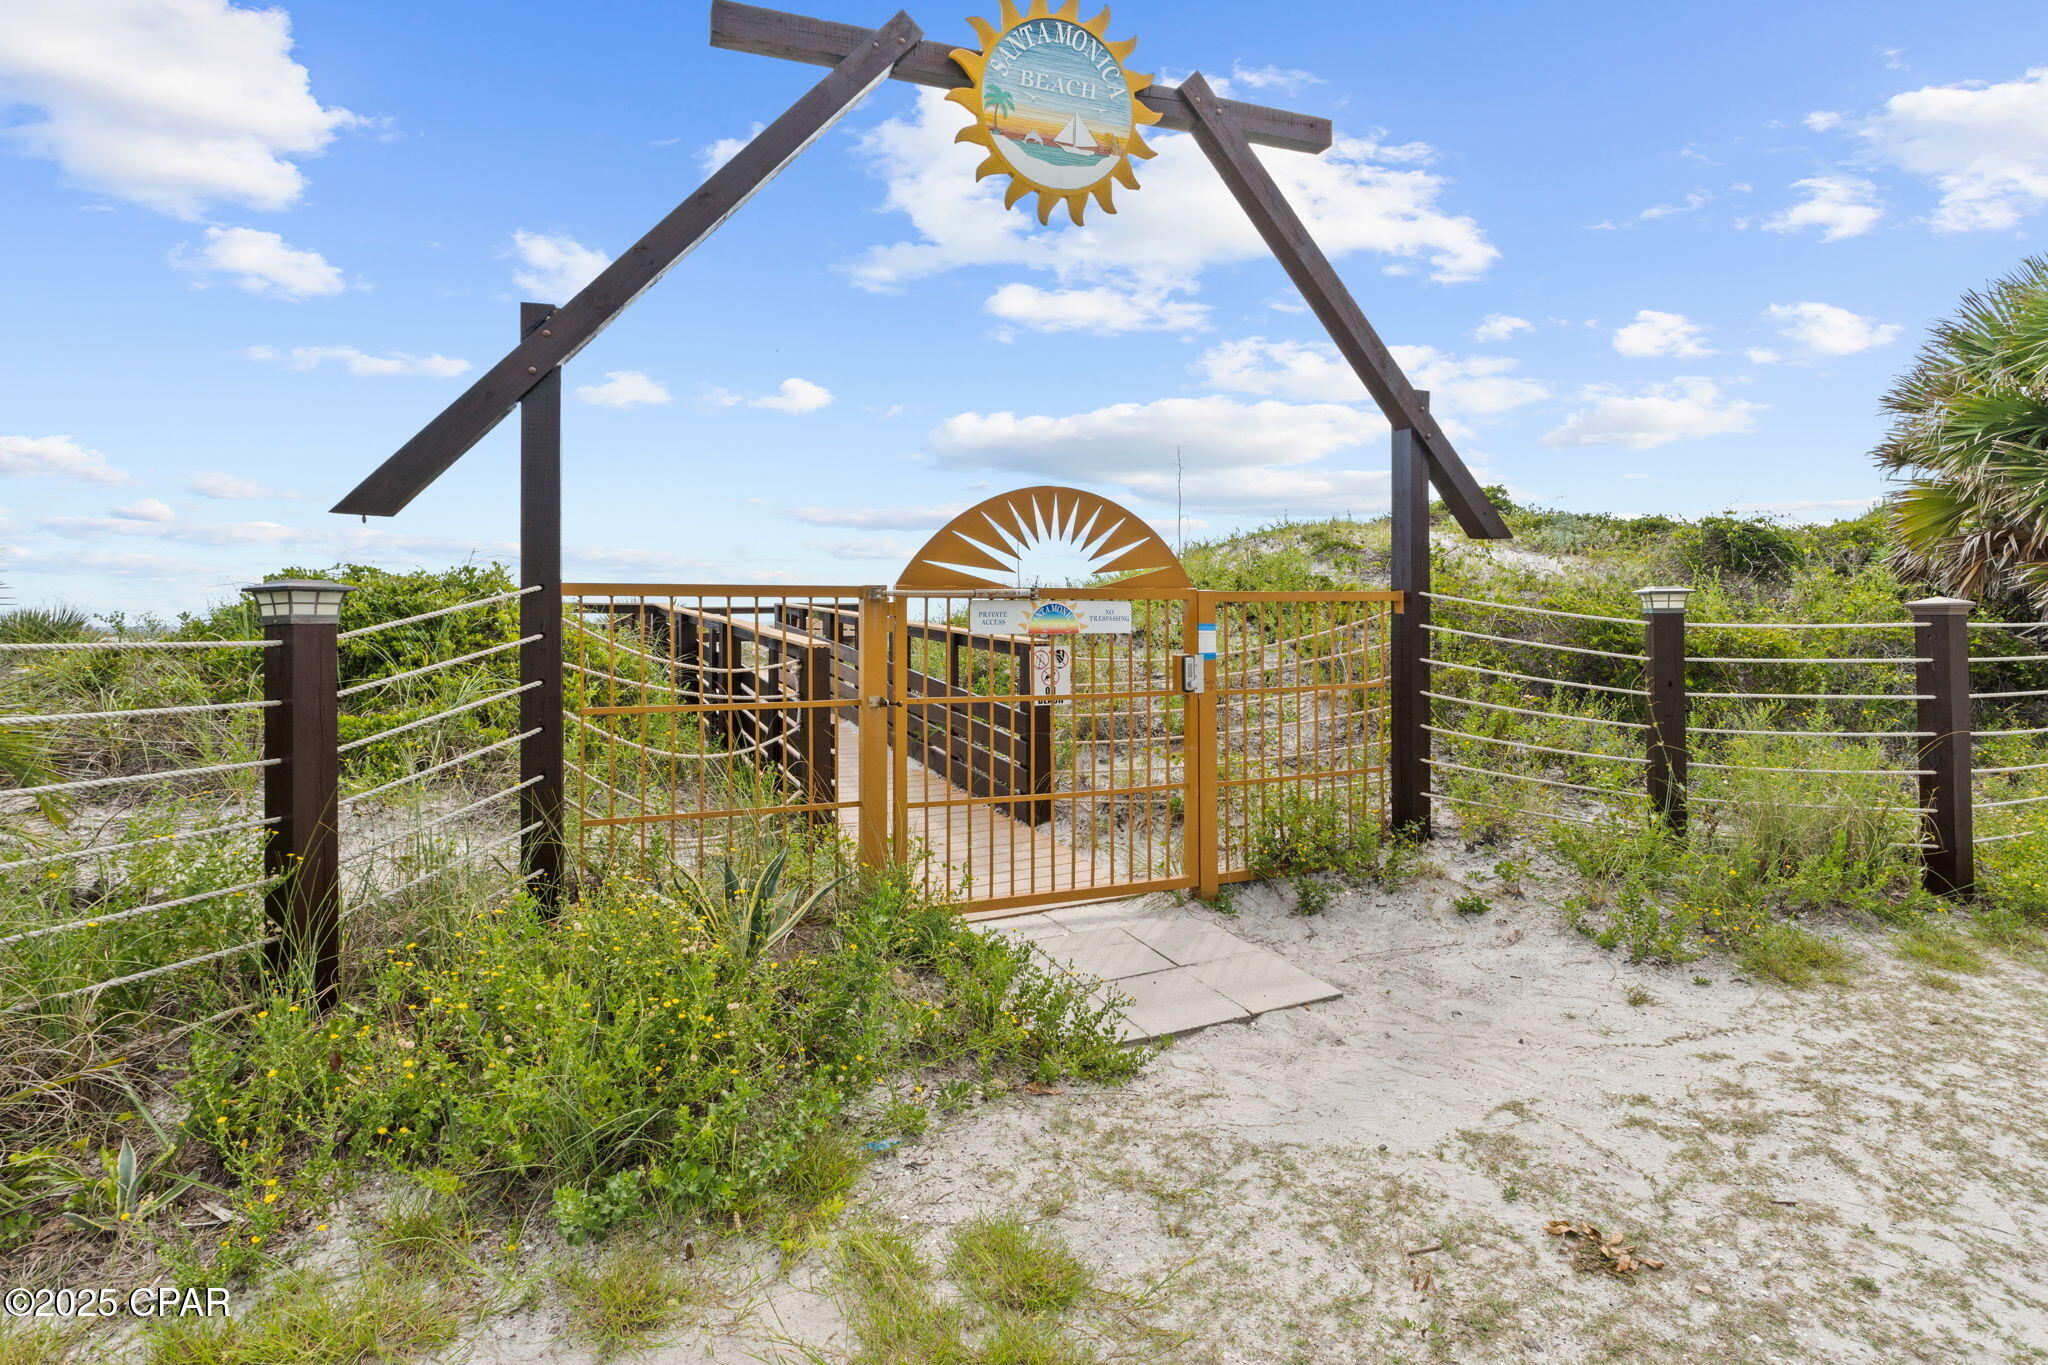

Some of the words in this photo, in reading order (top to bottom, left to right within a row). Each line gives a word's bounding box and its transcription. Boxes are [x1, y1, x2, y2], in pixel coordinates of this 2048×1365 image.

[989, 22, 1052, 78] SANTA
[1053, 21, 1126, 101] MONICA
[1019, 69, 1097, 100] BEACH
